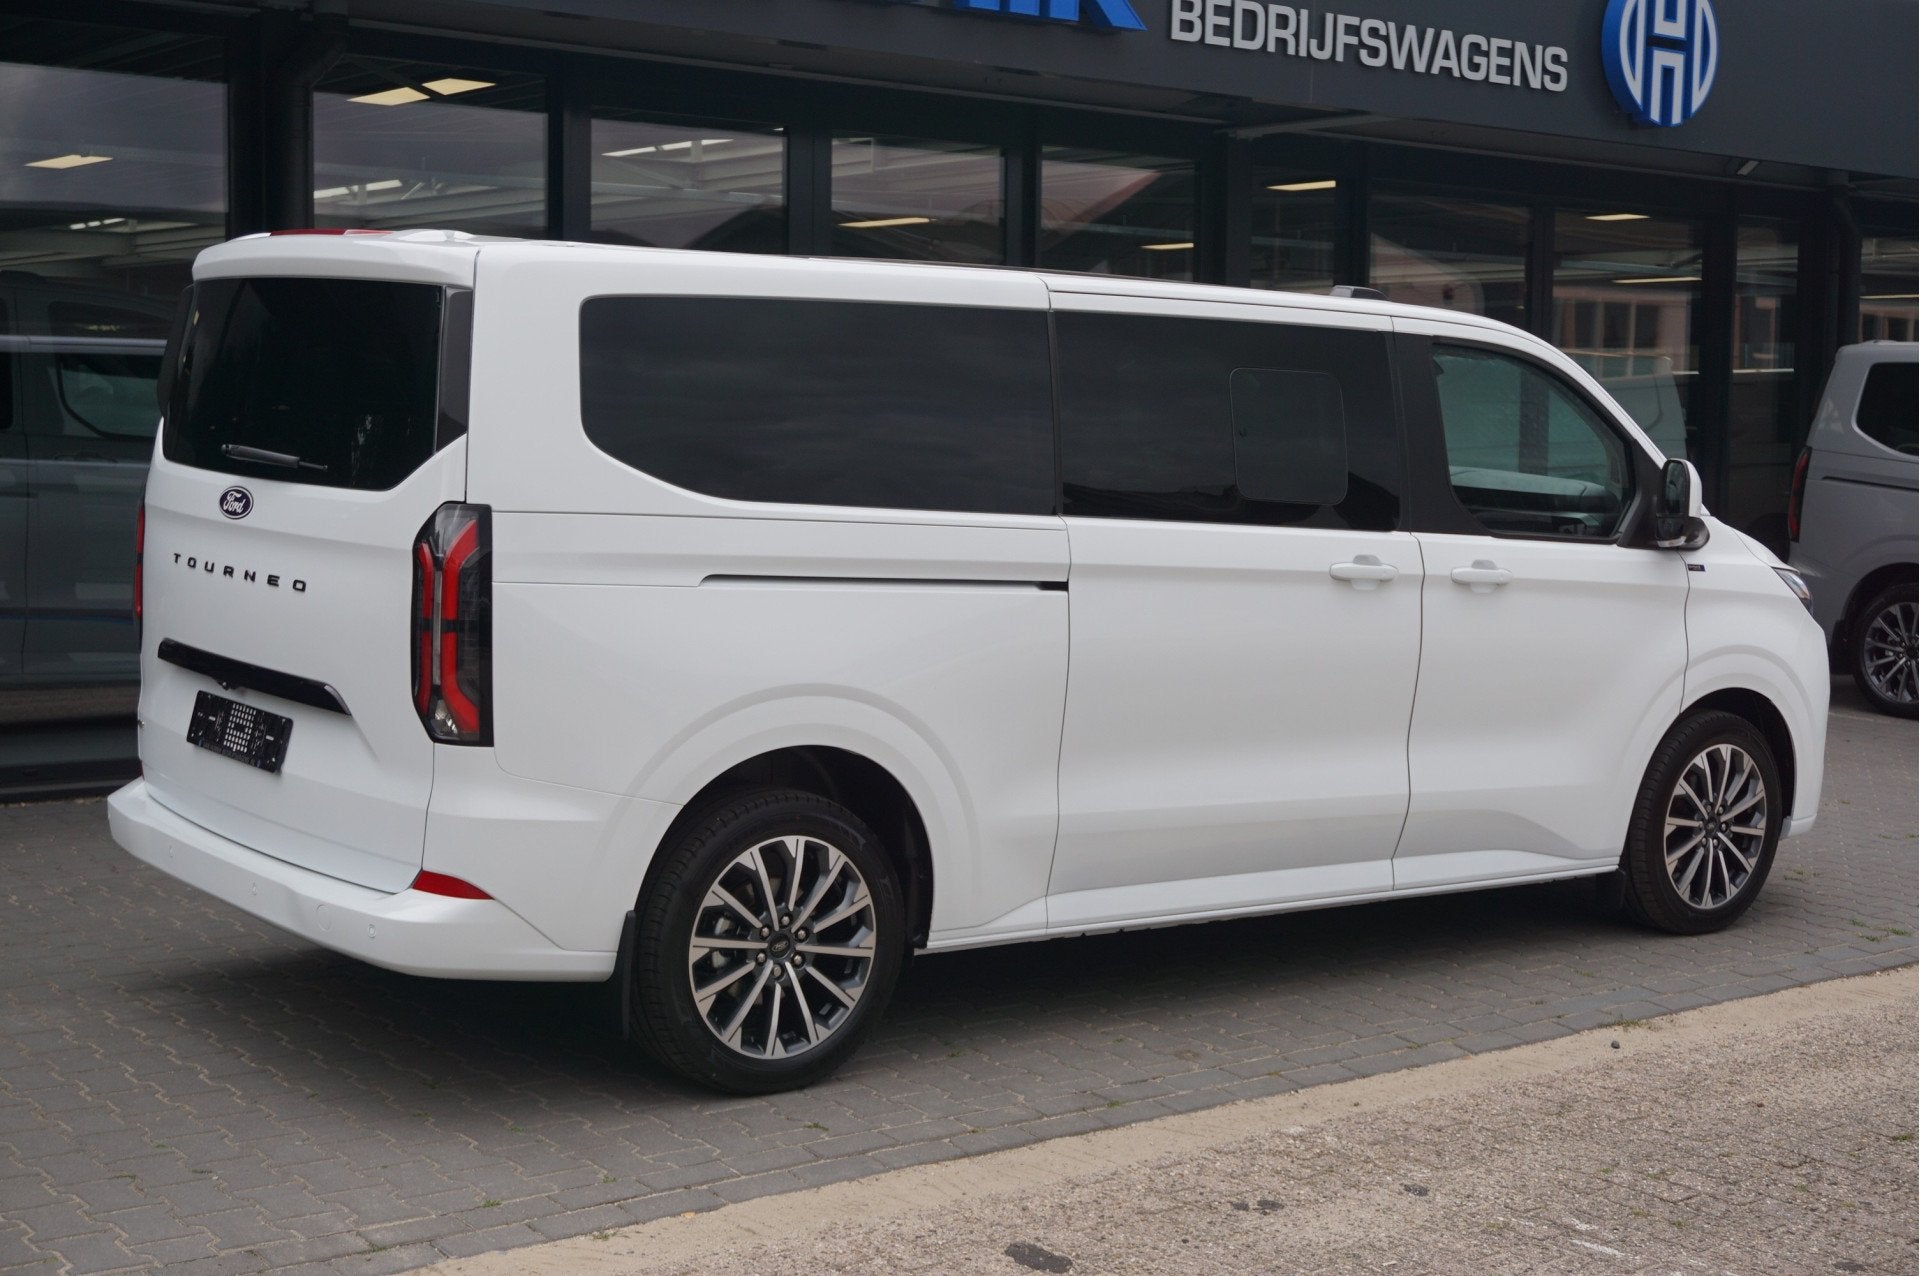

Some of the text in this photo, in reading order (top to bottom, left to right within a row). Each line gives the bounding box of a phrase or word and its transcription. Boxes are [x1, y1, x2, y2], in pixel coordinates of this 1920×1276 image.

[1171, 0, 1568, 92] BEDRIJFSWAGENS
[222, 490, 247, 514] Ford
[173, 552, 307, 593] TOURNEO
